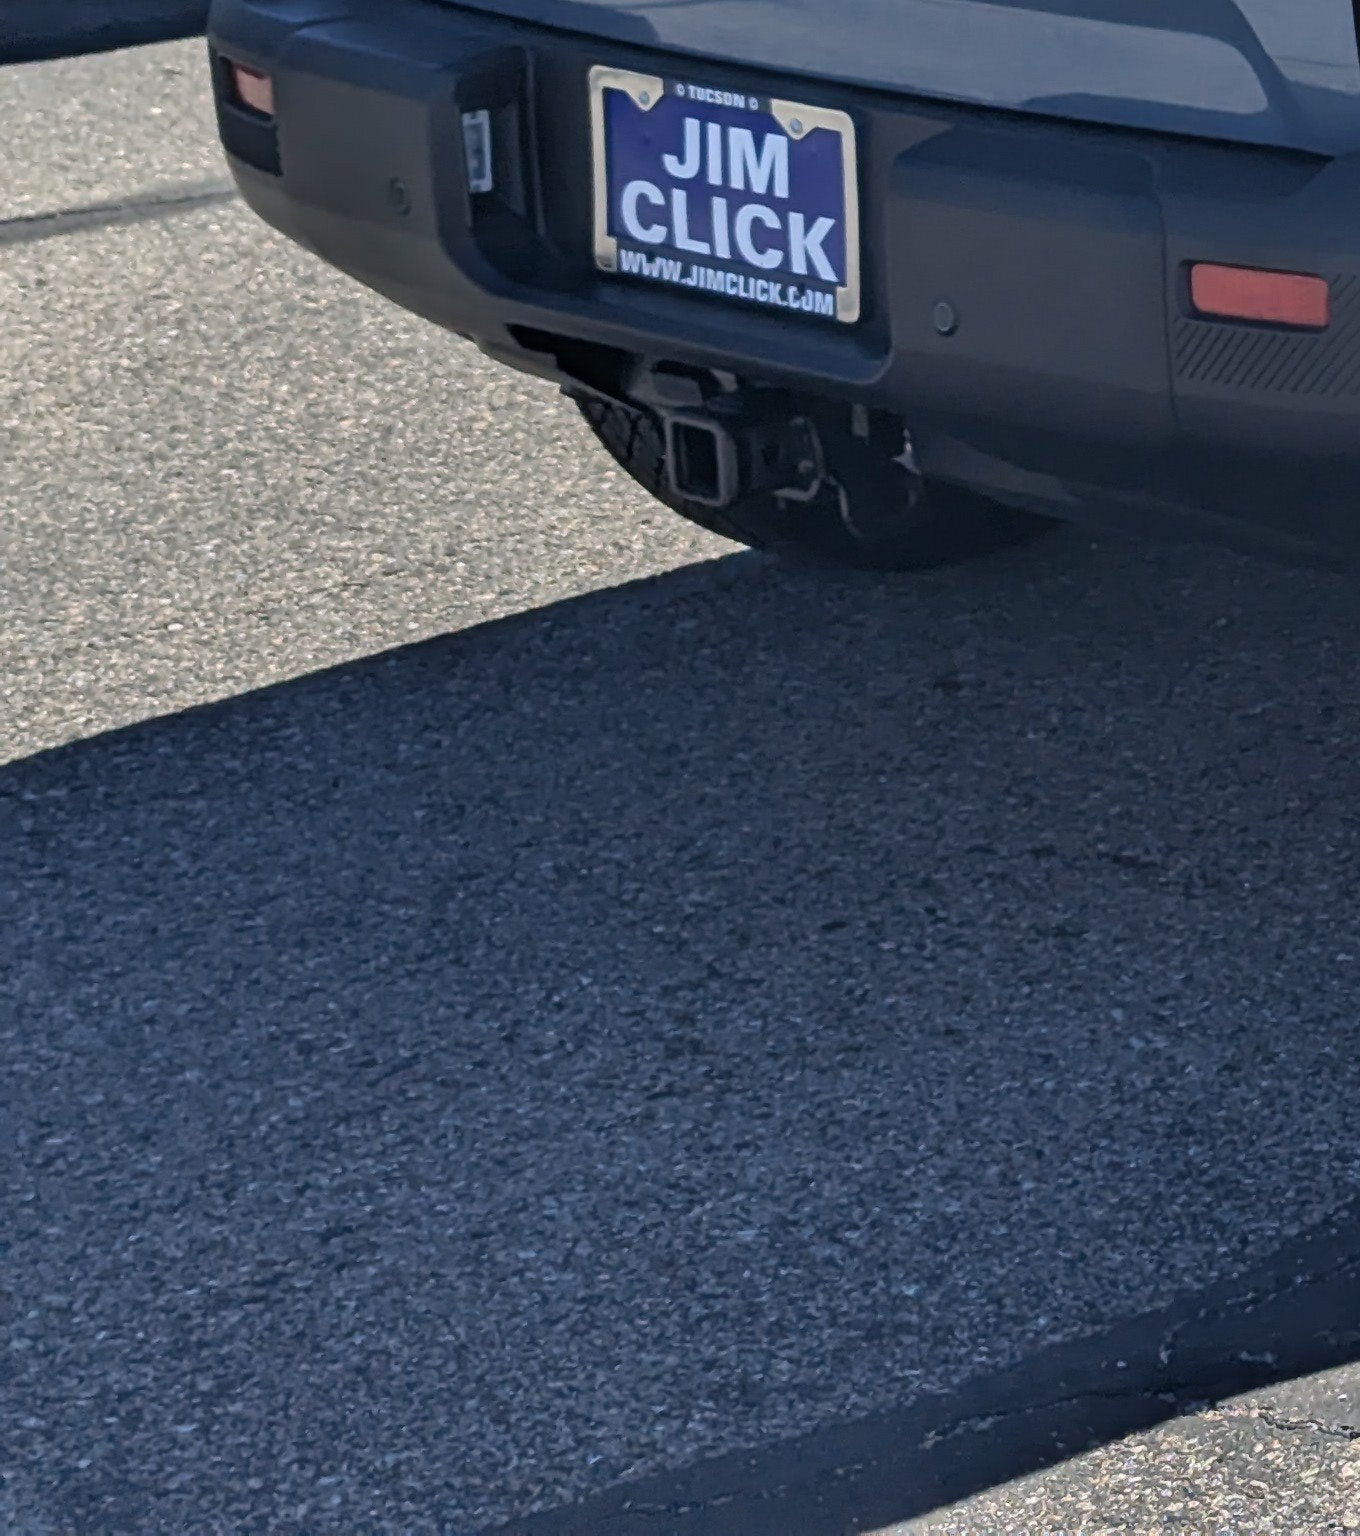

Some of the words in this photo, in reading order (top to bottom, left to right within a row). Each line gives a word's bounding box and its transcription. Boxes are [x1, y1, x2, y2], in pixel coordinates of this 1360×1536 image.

[687, 84, 746, 111] TUCSON
[662, 117, 790, 199] JIM
[620, 179, 840, 284] CLICK
[618, 248, 835, 317] WWW.JIMCLICK.COM
